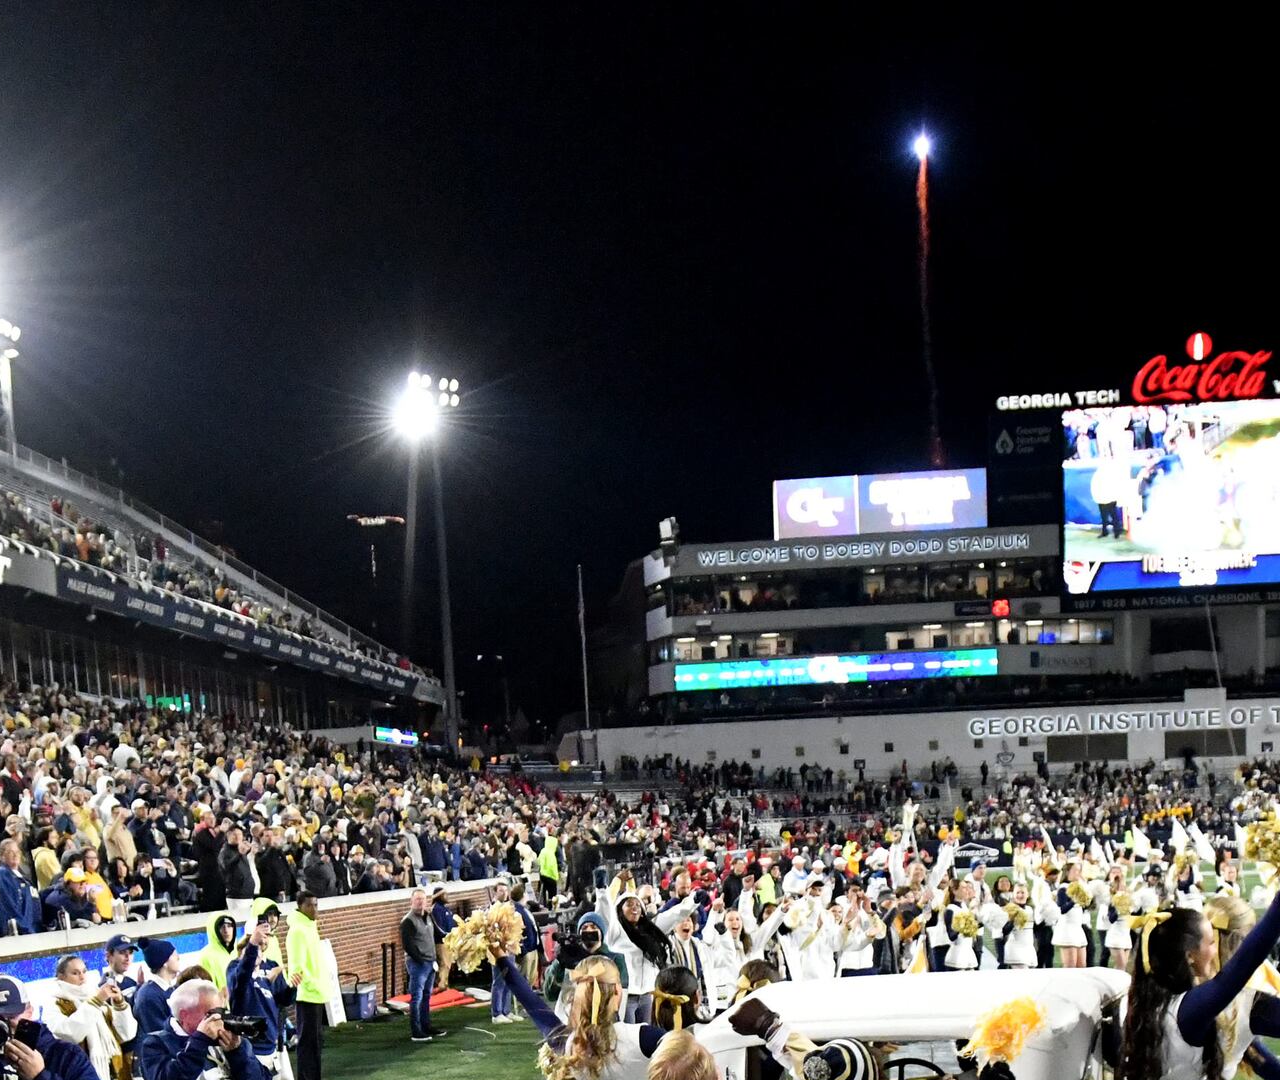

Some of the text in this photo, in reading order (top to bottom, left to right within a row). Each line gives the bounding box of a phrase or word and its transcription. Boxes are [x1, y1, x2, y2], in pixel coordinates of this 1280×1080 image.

[995, 389, 1120, 411] GEORGIA TECH
[697, 533, 1030, 567] WELCOME TO BOBBY DODD STADIUM
[1132, 596, 1190, 607] NATIONAL
[1193, 592, 1261, 605] CHAMPIONS
[968, 714, 1082, 738] GEORGIA
[1088, 706, 1222, 733] INSTITUTE
[1229, 705, 1263, 726] OF
[955, 849, 987, 857] OUTHEAST
